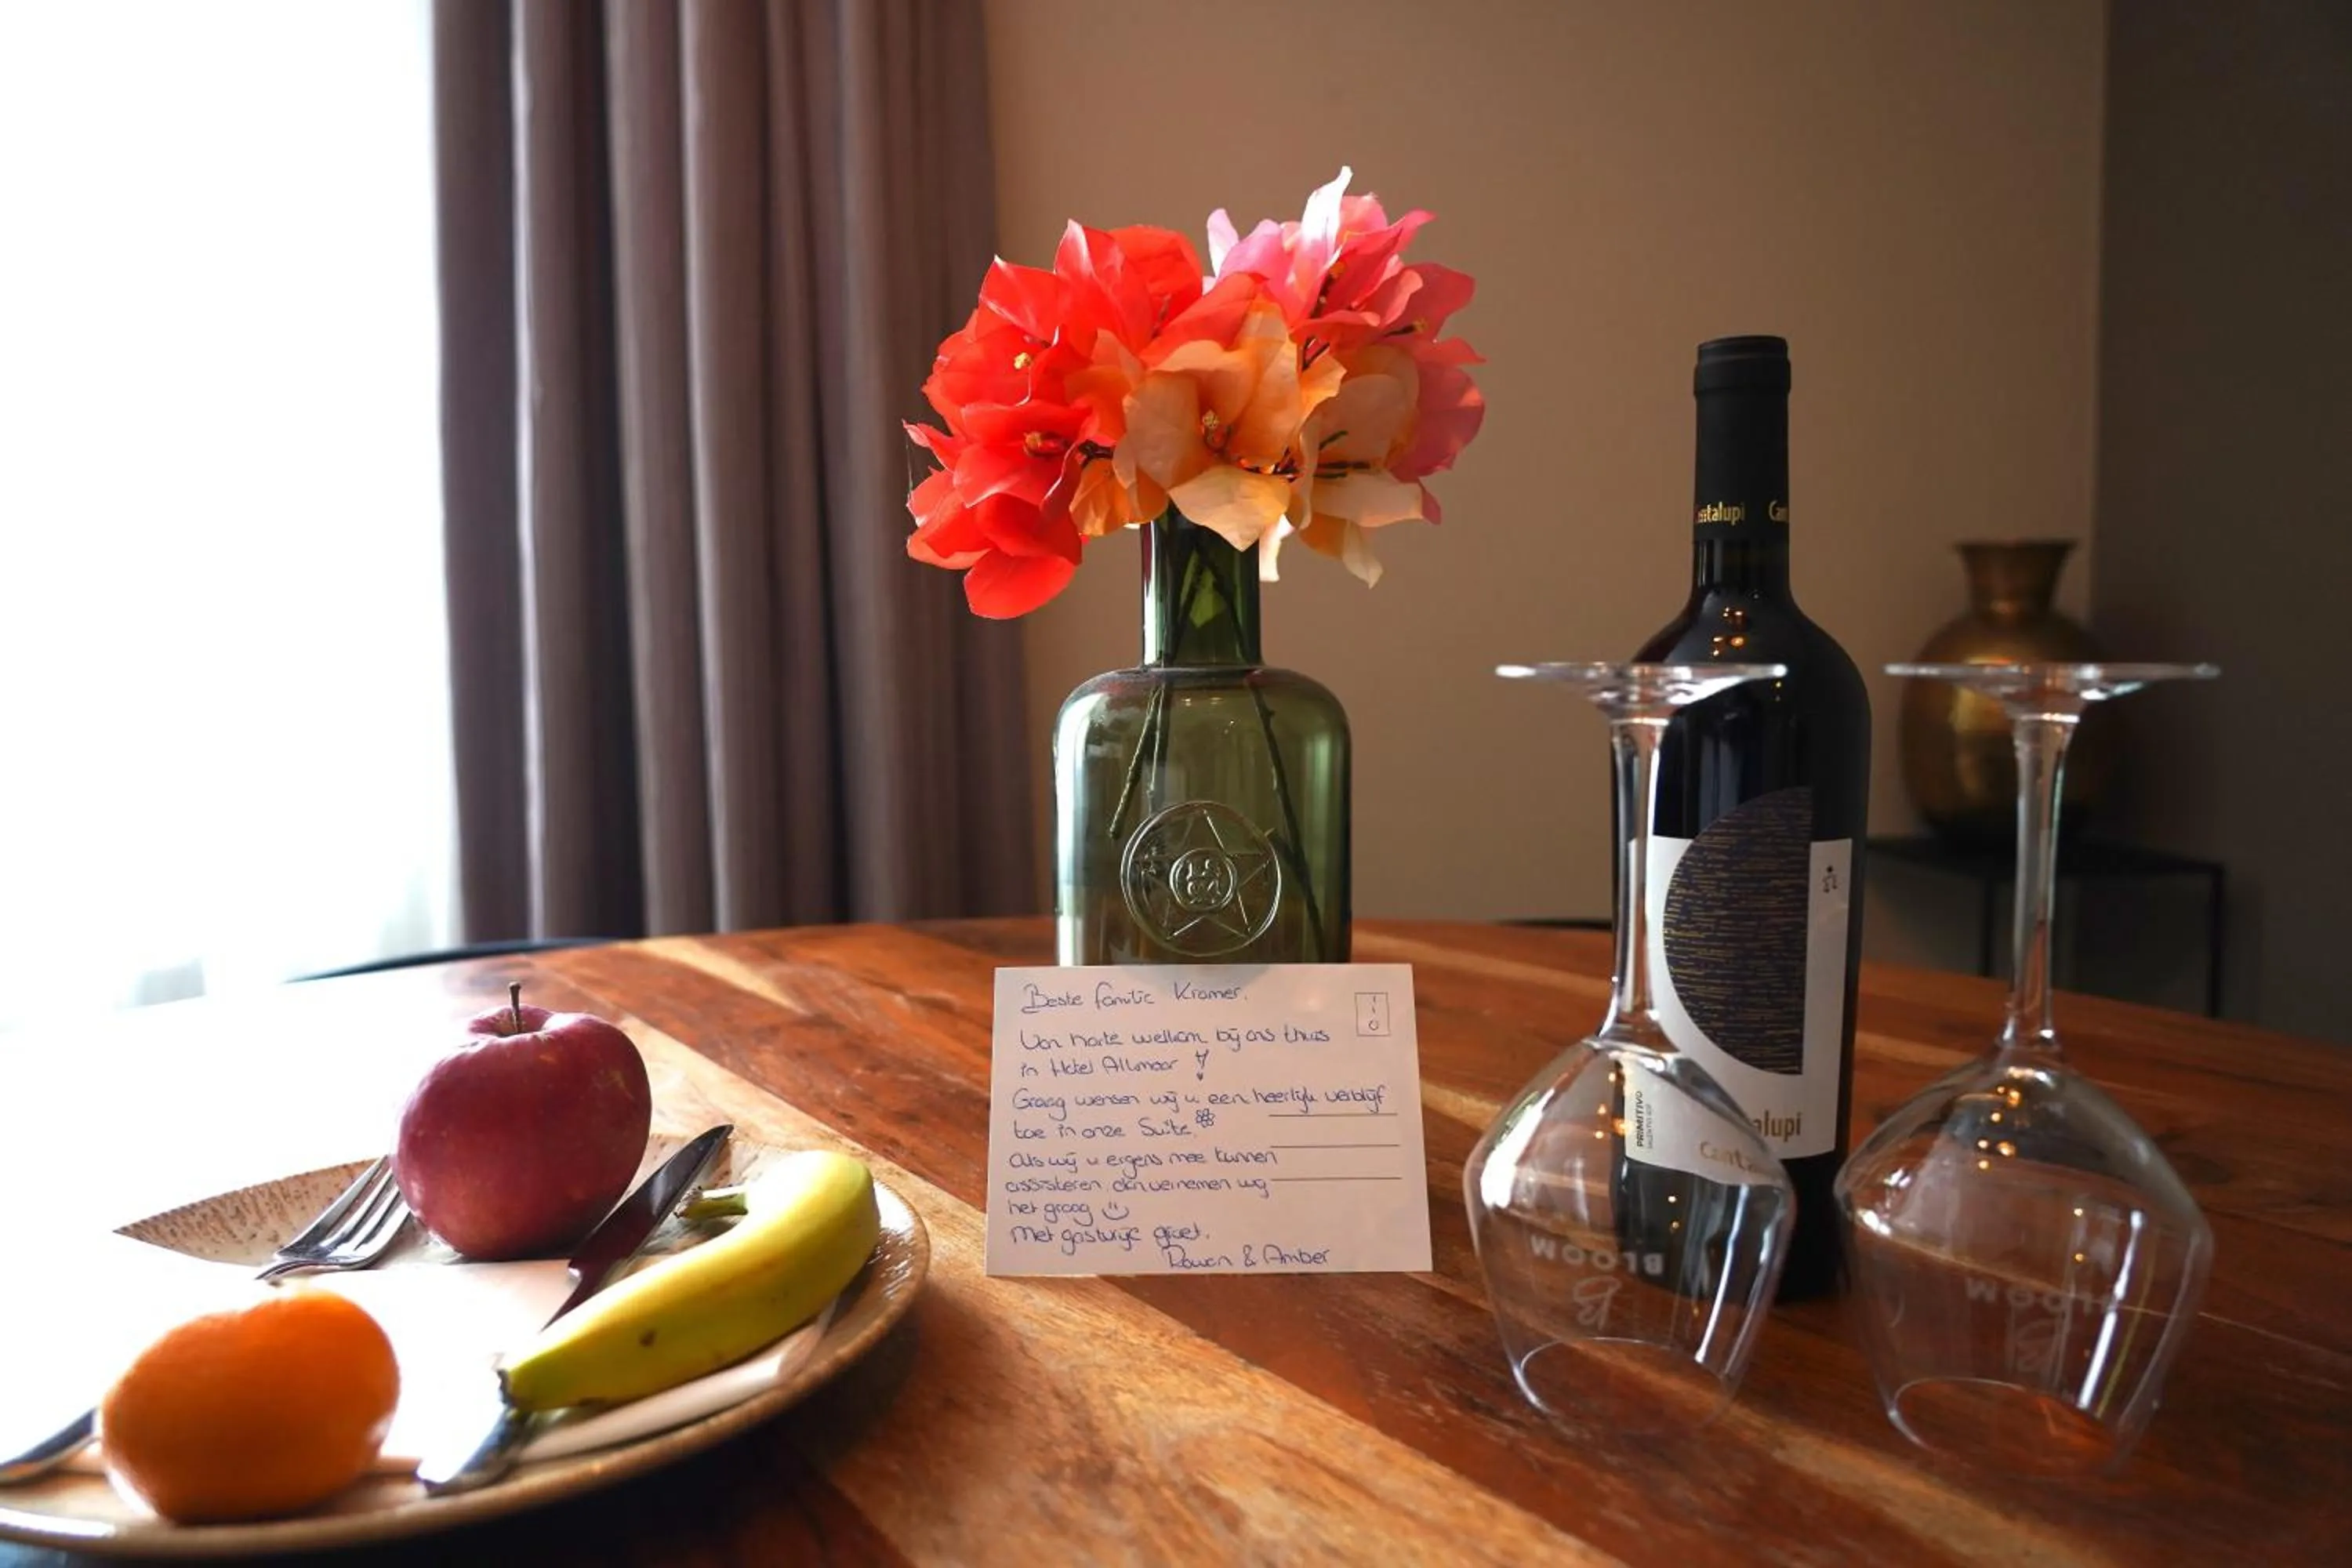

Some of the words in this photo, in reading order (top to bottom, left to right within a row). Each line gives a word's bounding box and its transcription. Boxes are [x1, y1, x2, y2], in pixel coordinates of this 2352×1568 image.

[1021, 983, 1083, 1014] Beste
[1021, 1063, 1039, 1077] in
[1051, 1058, 1094, 1077] Hotel
[1013, 1088, 1067, 1121] Graag
[1075, 1094, 1139, 1106] wensen
[1208, 1093, 1250, 1105] een
[1013, 1120, 1047, 1139] toe
[1058, 1123, 1077, 1138] in
[1081, 1125, 1127, 1139] onze
[1635, 1091, 1645, 1148] PRIMITIVO
[1087, 1157, 1098, 1166] u
[1106, 1155, 1163, 1180] ergens
[1169, 1152, 1207, 1164] mee
[1007, 1200, 1039, 1214] het
[1044, 1203, 1094, 1227] graag
[1011, 1225, 1054, 1244] Met
[1243, 1244, 1256, 1268] &
[1263, 1243, 1330, 1265] Amber
[1530, 1235, 1664, 1276] BLOOM
